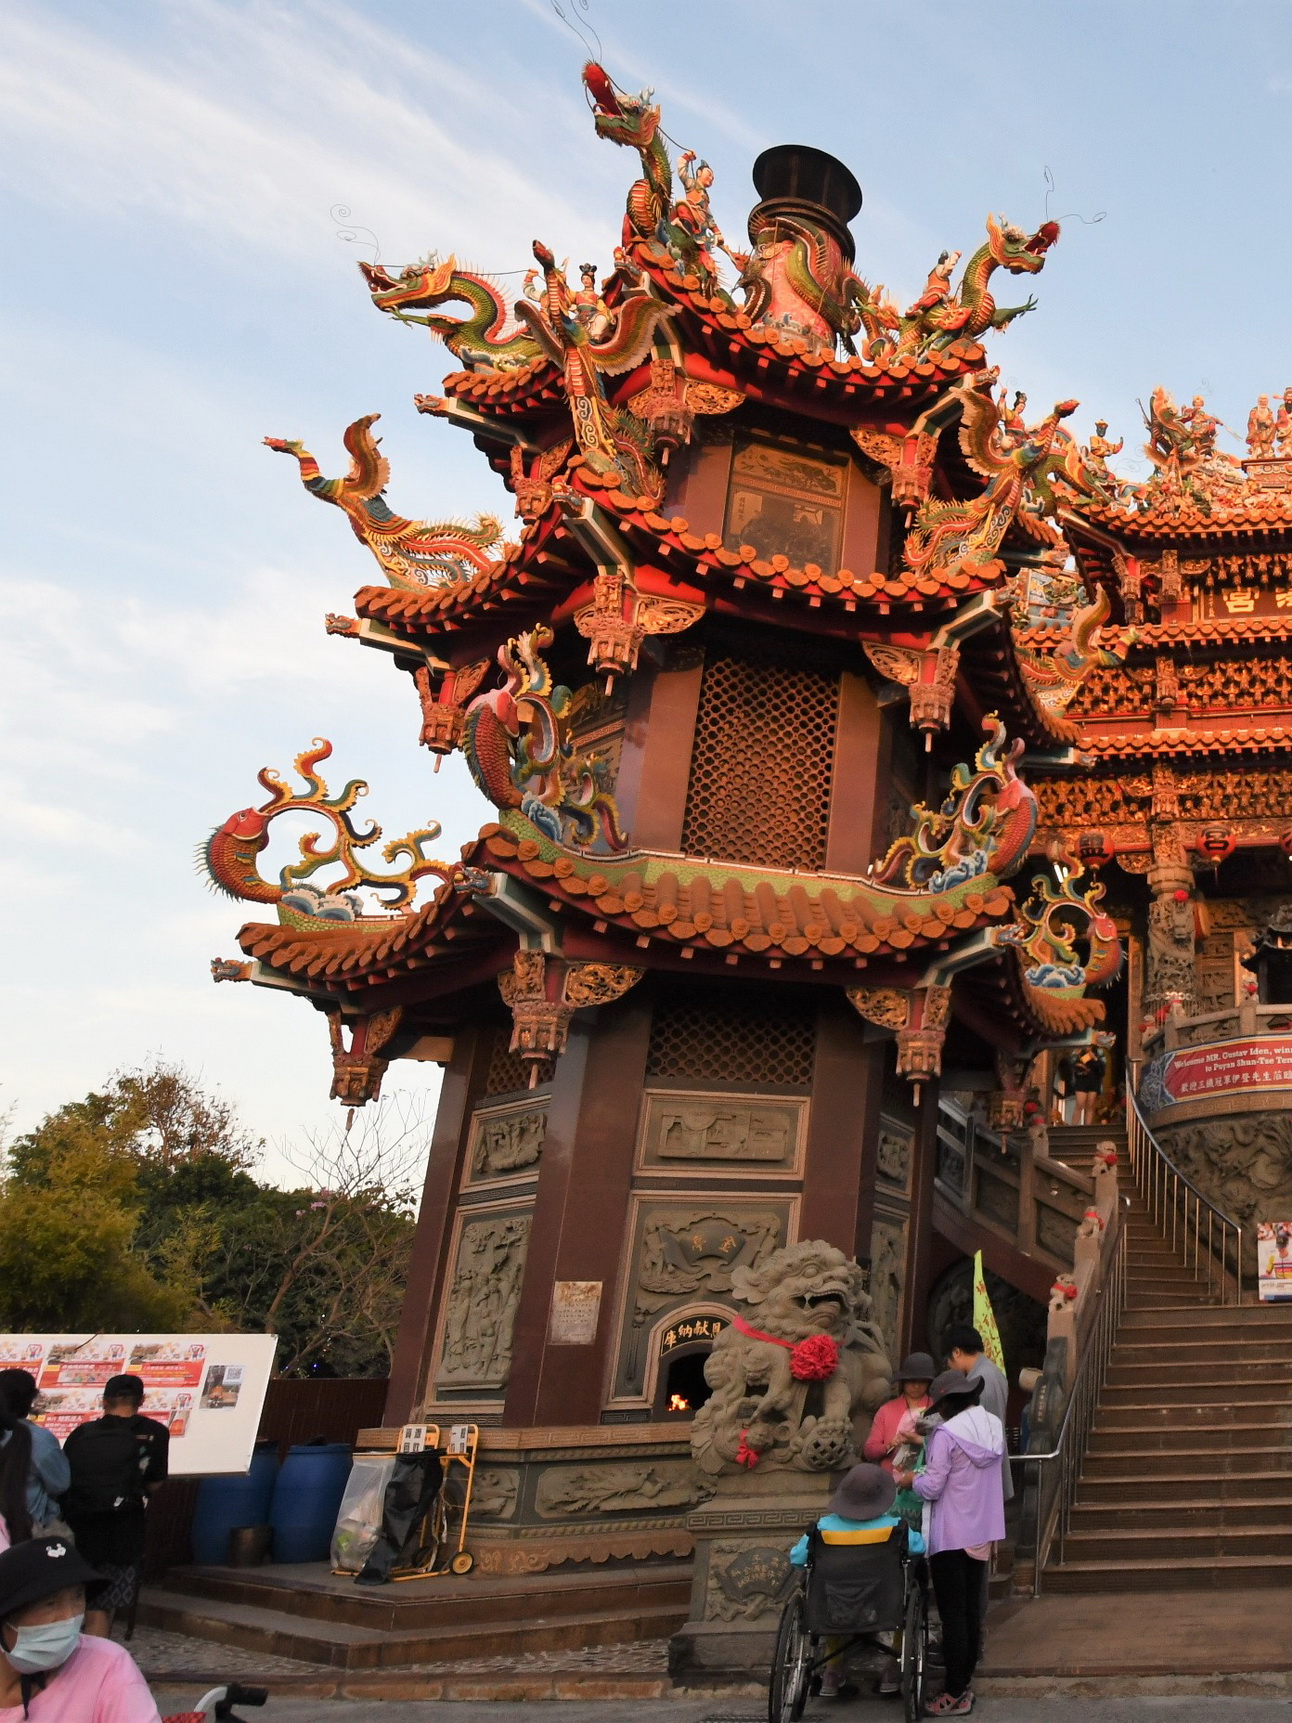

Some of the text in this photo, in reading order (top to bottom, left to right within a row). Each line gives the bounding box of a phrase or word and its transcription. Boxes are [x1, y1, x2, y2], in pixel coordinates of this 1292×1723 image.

[1174, 1056, 1205, 1069] Welcome
[1205, 1054, 1221, 1063] MR.
[1222, 1050, 1249, 1060] Gustav
[1249, 1047, 1272, 1056] Iden,
[1205, 1065, 1212, 1073] to
[1236, 1057, 1275, 1066] Shun-Tse
